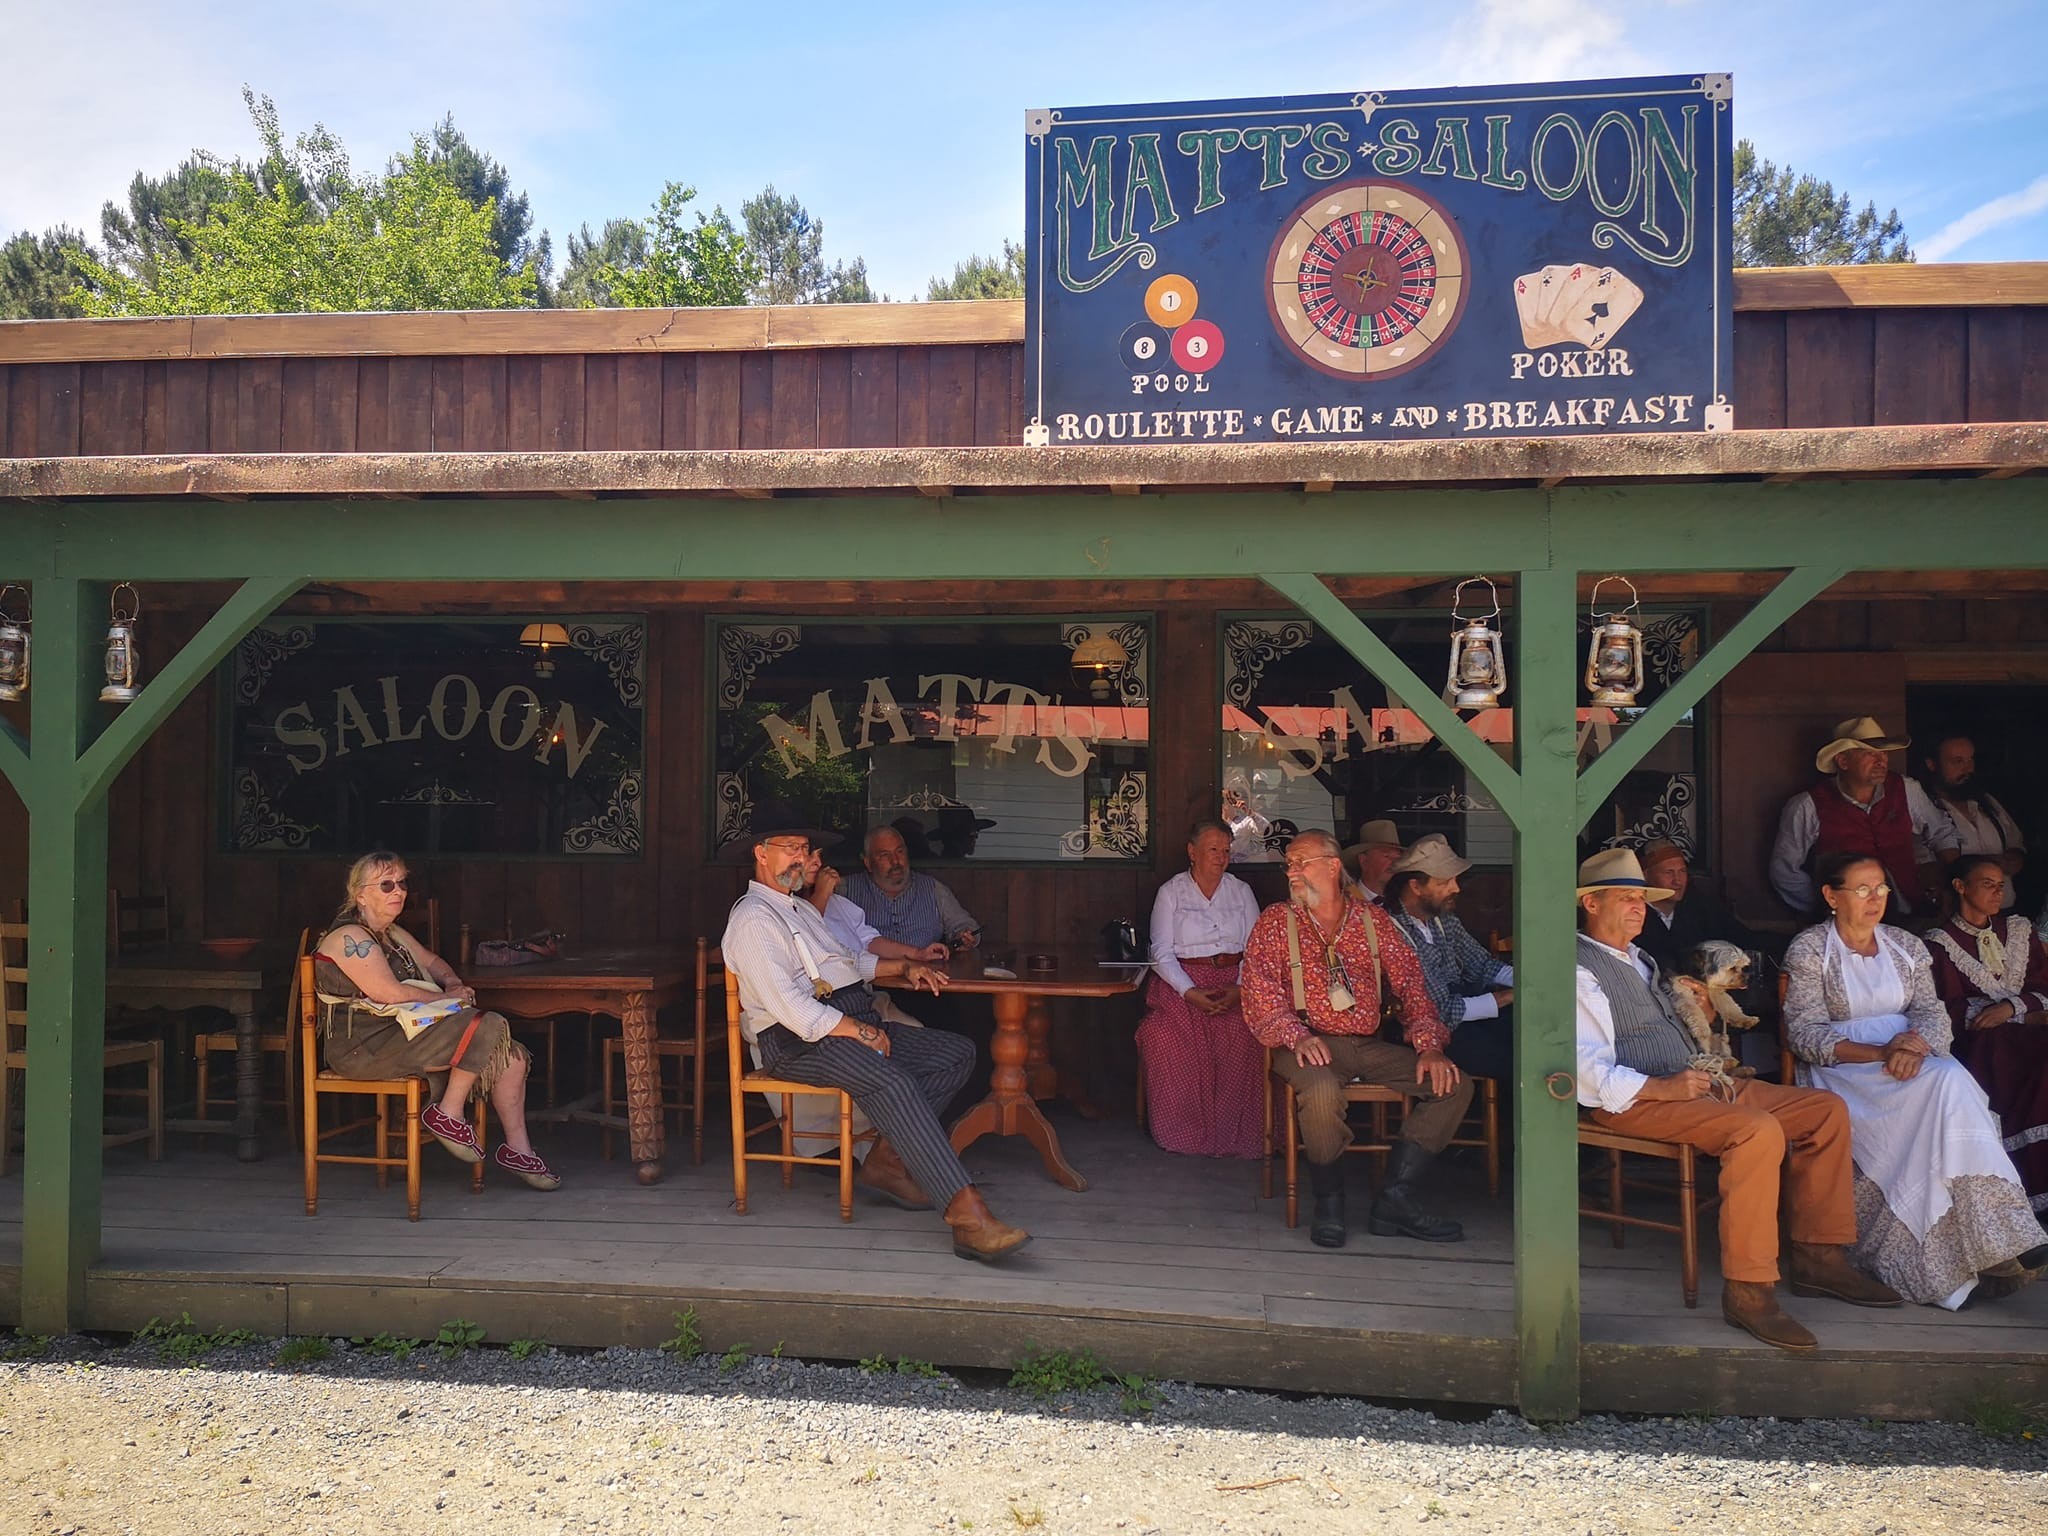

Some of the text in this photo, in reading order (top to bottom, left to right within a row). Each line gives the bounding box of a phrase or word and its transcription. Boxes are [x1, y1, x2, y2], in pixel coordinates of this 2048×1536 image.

[1055, 105, 1699, 293] MATT'S SALOON
[1362, 216, 1372, 225] 00
[1412, 240, 1422, 249] 8
[1167, 295, 1173, 307] 1
[1314, 310, 1320, 318] 7
[1408, 314, 1416, 322] 4
[1390, 326, 1400, 336] 35
[1342, 332, 1349, 341] 9
[1362, 336, 1368, 344] 0
[1372, 334, 1380, 342] 2
[1141, 341, 1149, 354] 8
[1194, 342, 1201, 353] 3
[1510, 348, 1634, 379] POKER
[1131, 373, 1210, 394] POOL
[1056, 394, 1694, 441] ROULETTE GAME AND BREAKFAST
[274, 673, 609, 780] SALOON
